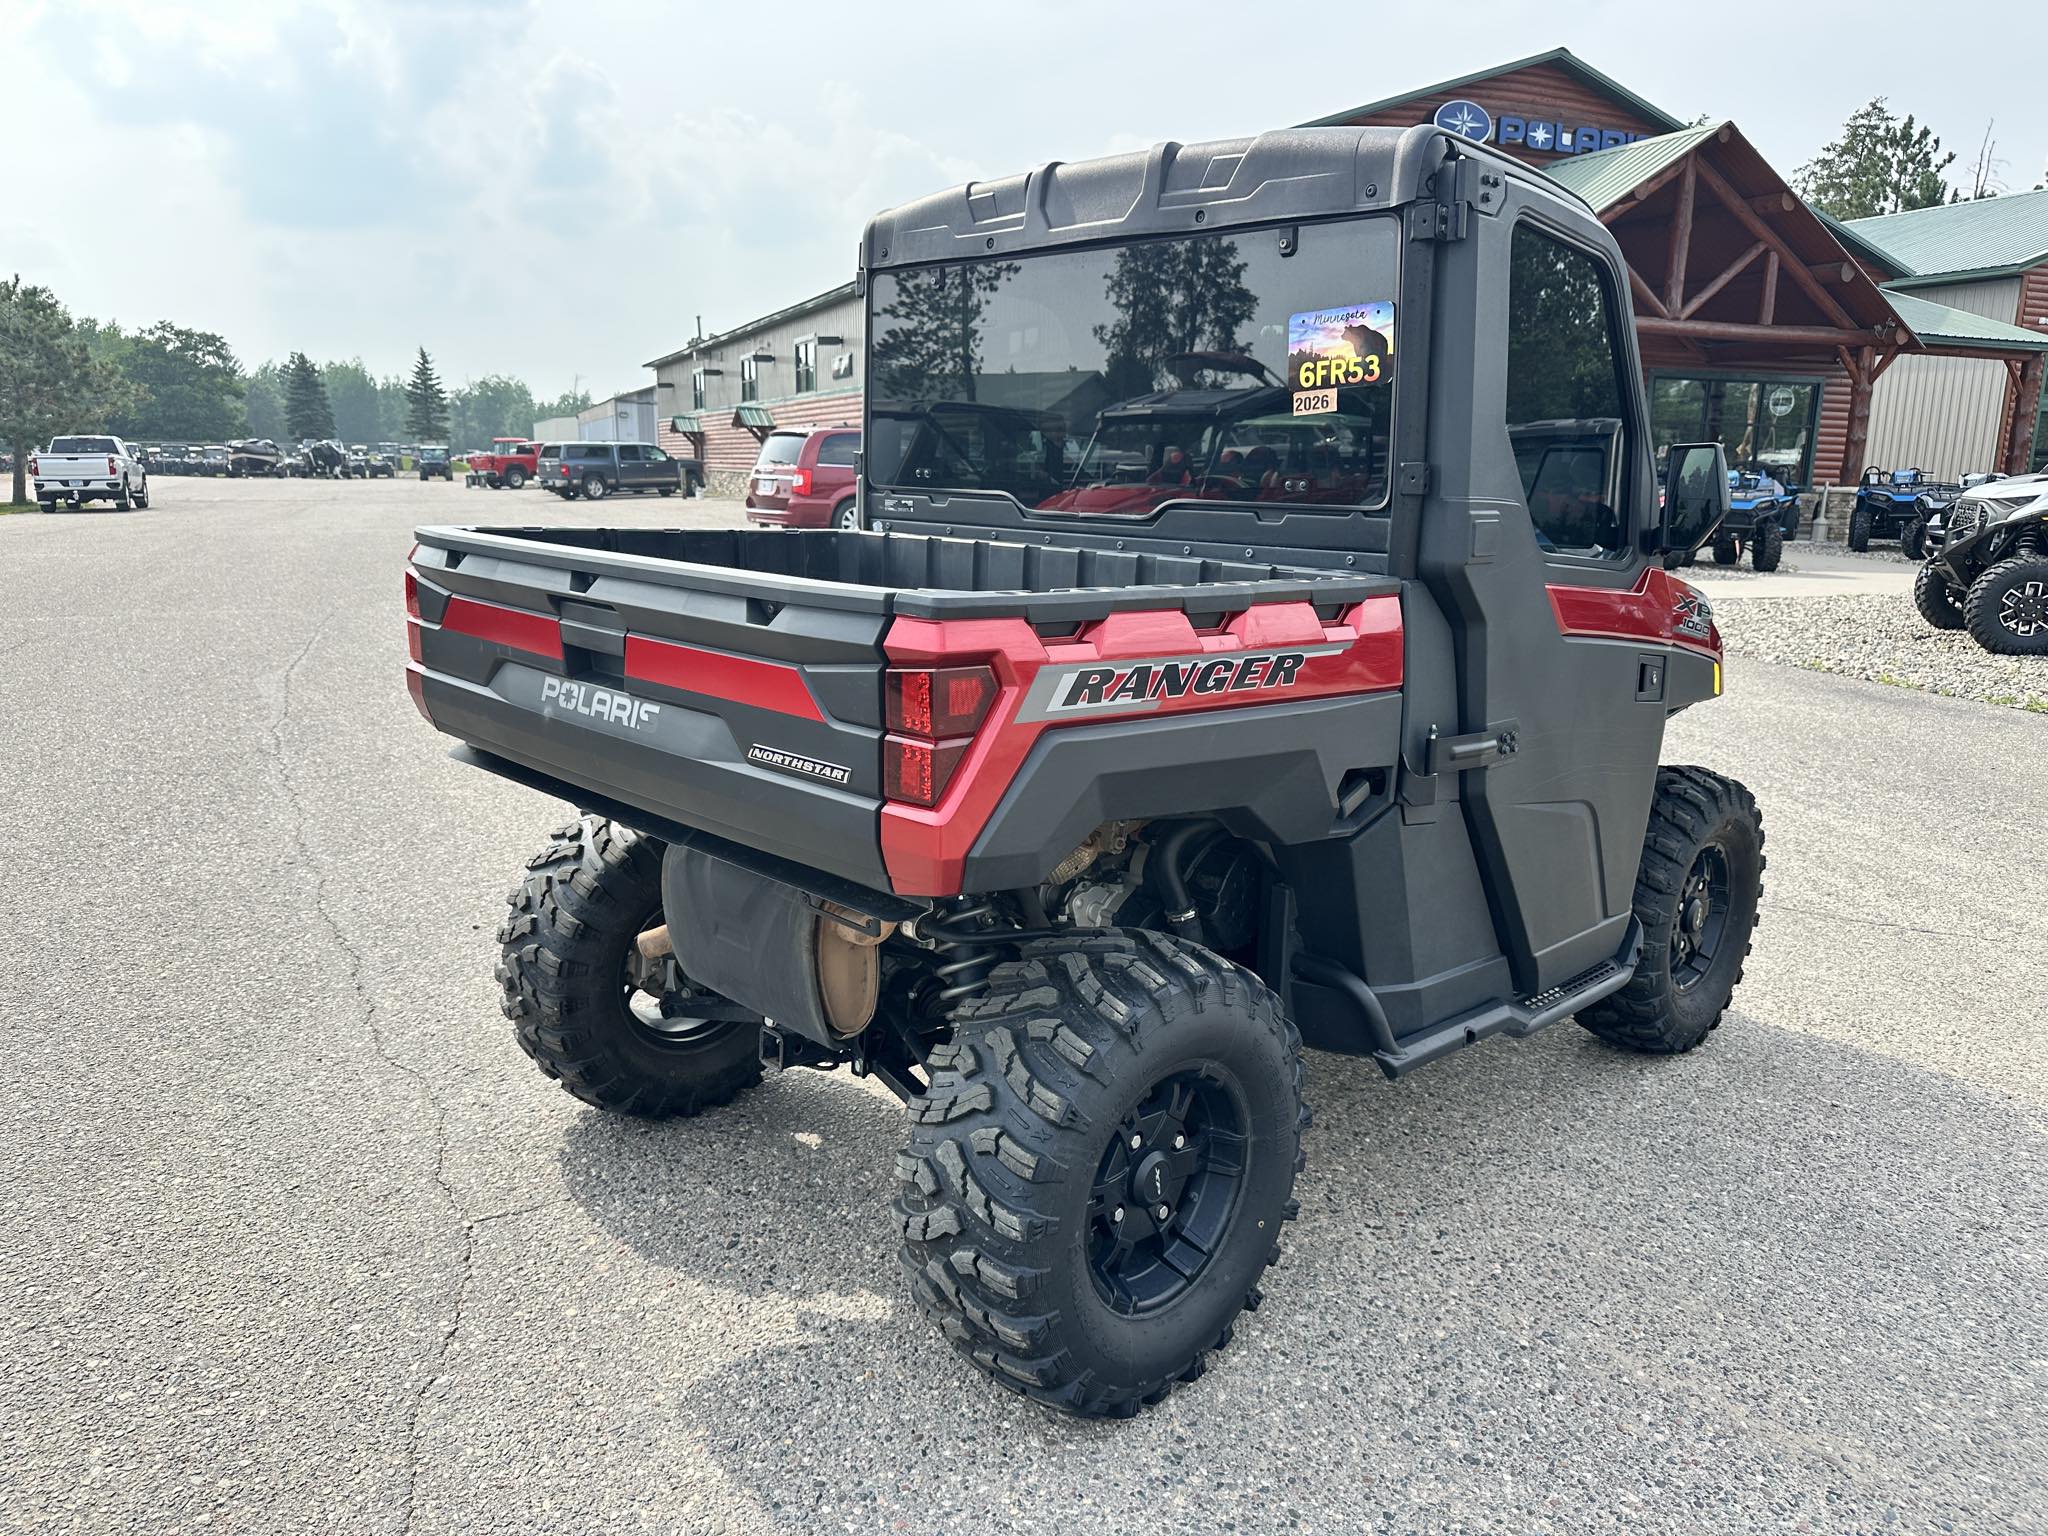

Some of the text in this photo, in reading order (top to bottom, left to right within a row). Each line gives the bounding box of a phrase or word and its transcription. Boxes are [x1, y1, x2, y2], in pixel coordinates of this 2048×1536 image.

[1498, 116, 1655, 154] POLAR
[1313, 309, 1368, 325] Minnesota
[1299, 354, 1381, 388] 6FR53
[1295, 394, 1330, 412] 2026
[1673, 592, 1712, 618] XP
[1682, 617, 1711, 636] 1000
[1060, 652, 1306, 708] RANGER
[752, 748, 845, 780] NORTHSTAR
